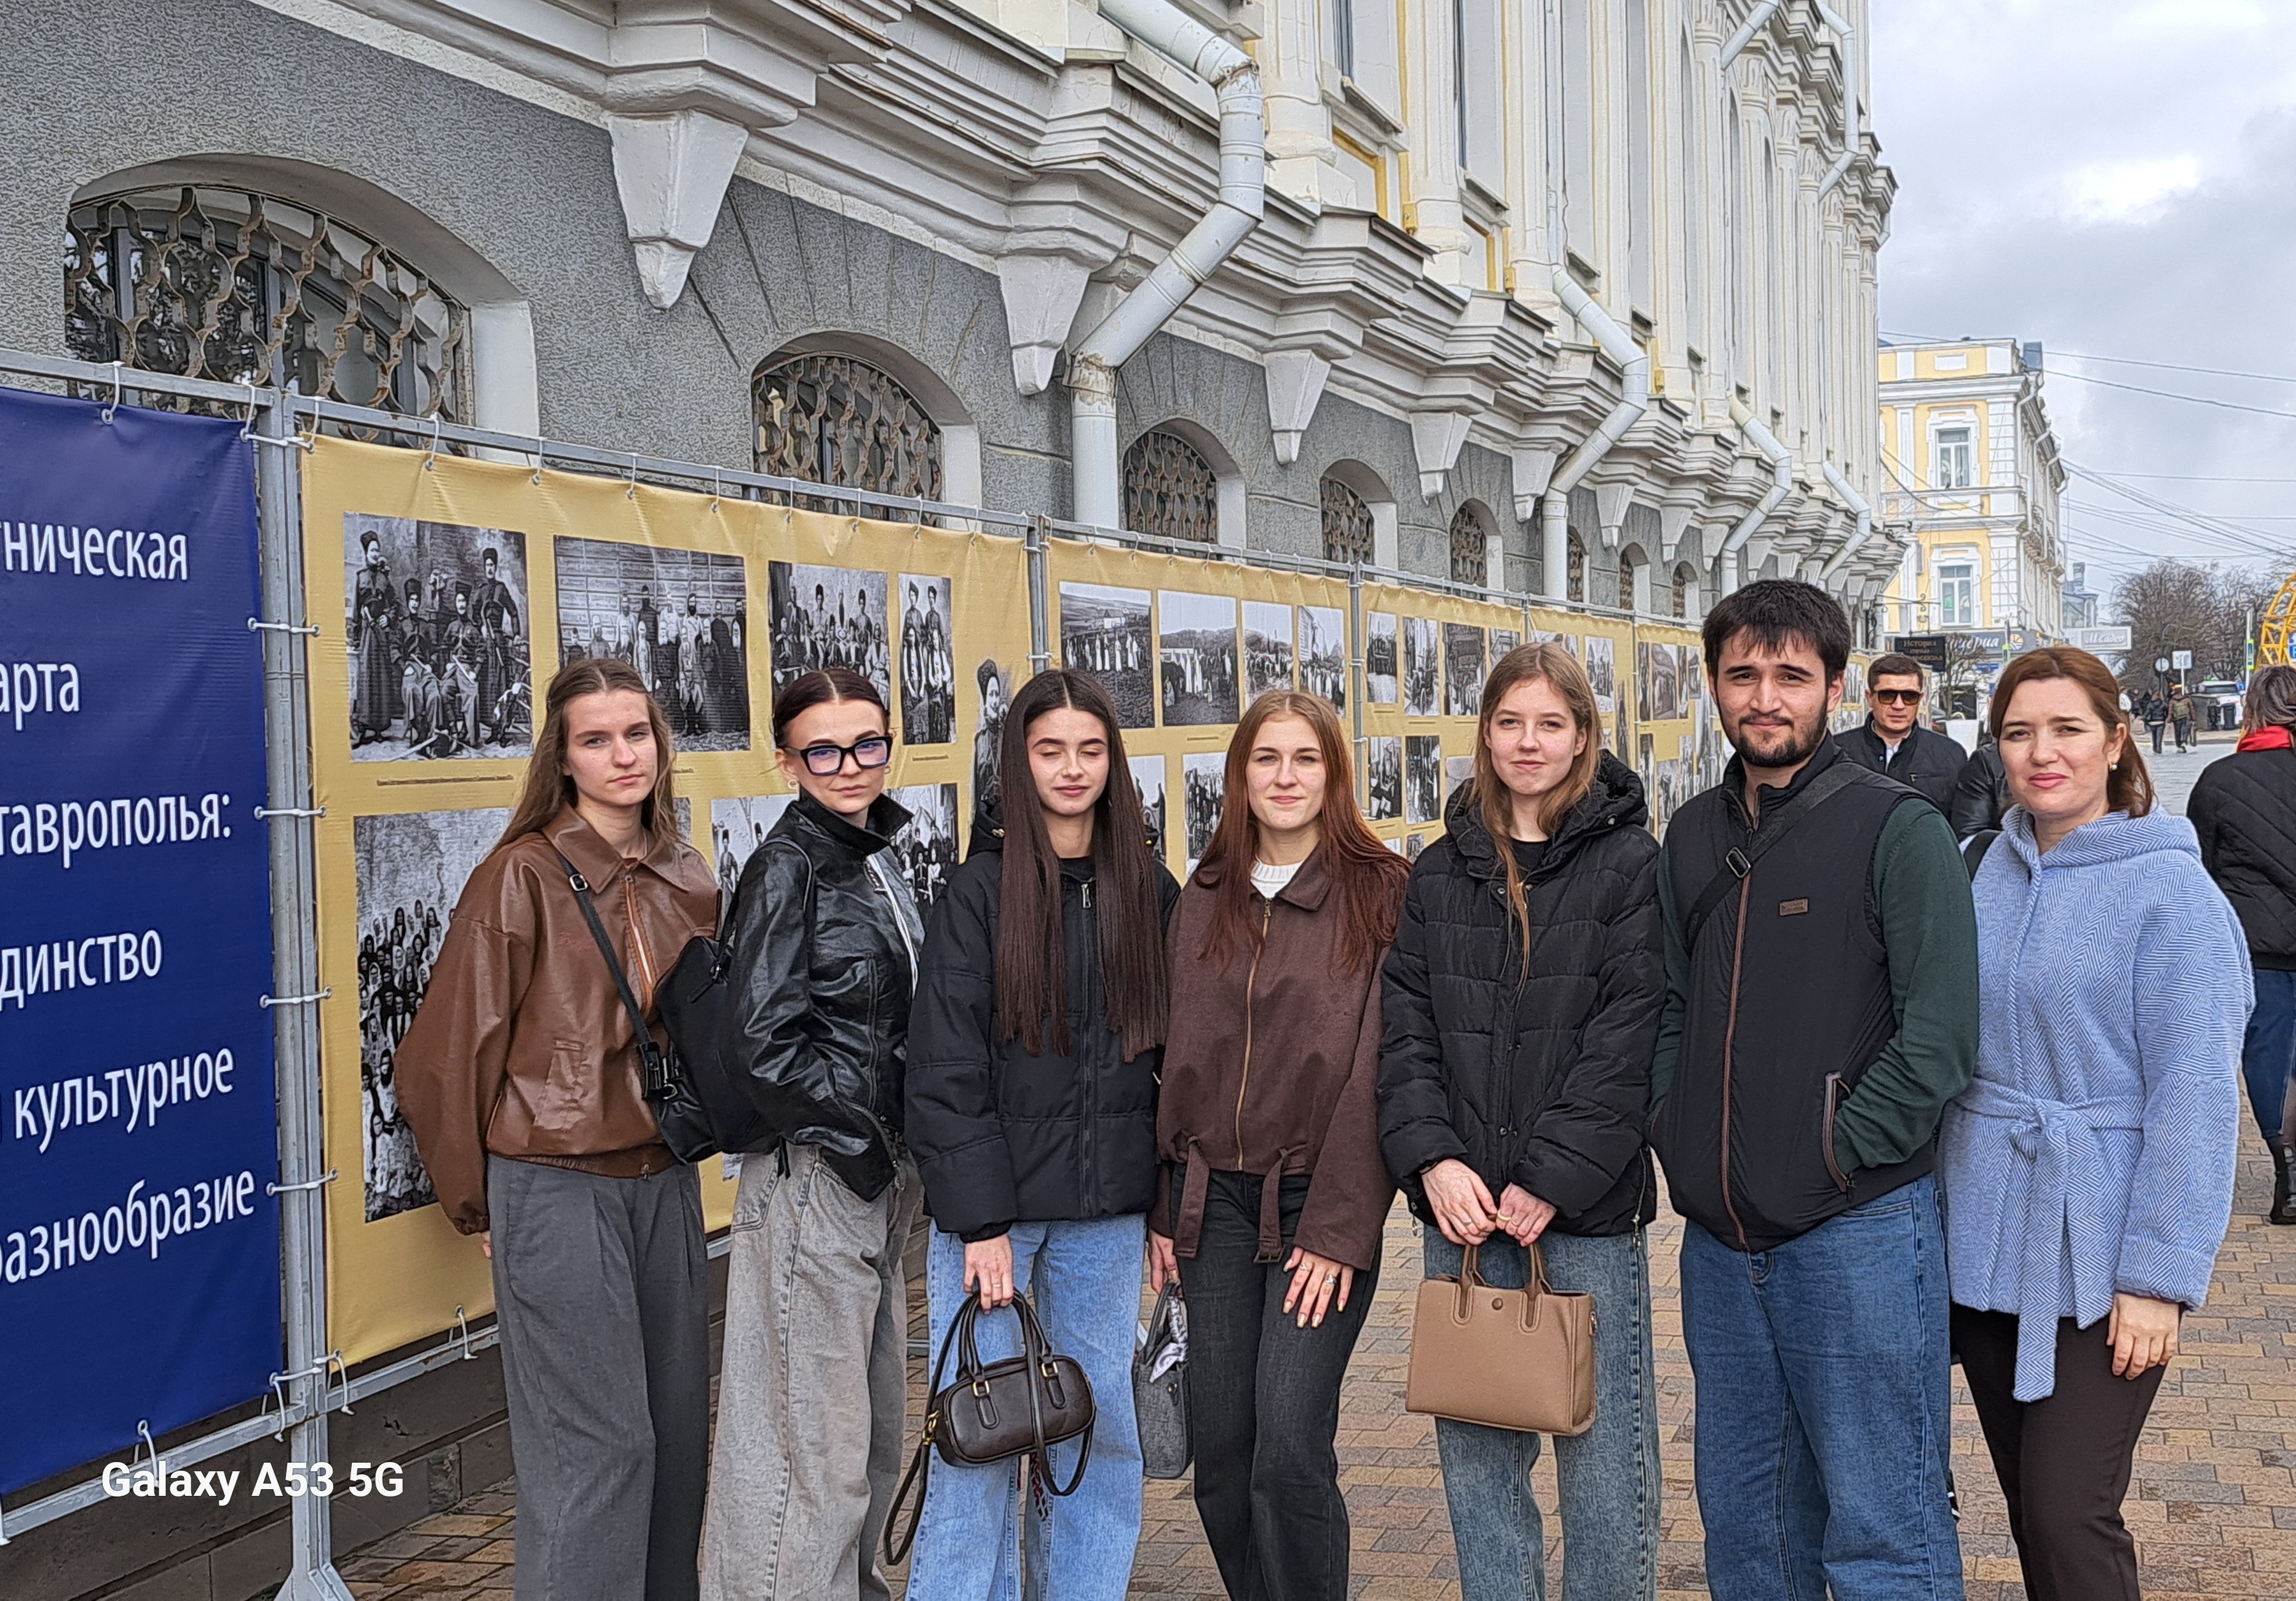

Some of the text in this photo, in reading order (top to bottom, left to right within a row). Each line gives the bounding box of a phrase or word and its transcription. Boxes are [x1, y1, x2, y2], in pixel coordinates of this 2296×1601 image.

[0, 521, 188, 580] ническая
[0, 663, 80, 730] арта
[0, 794, 231, 869] таврополья:
[0, 930, 162, 1011] динство
[14, 1048, 234, 1154] культурное
[0, 1171, 255, 1283] азнообразие
